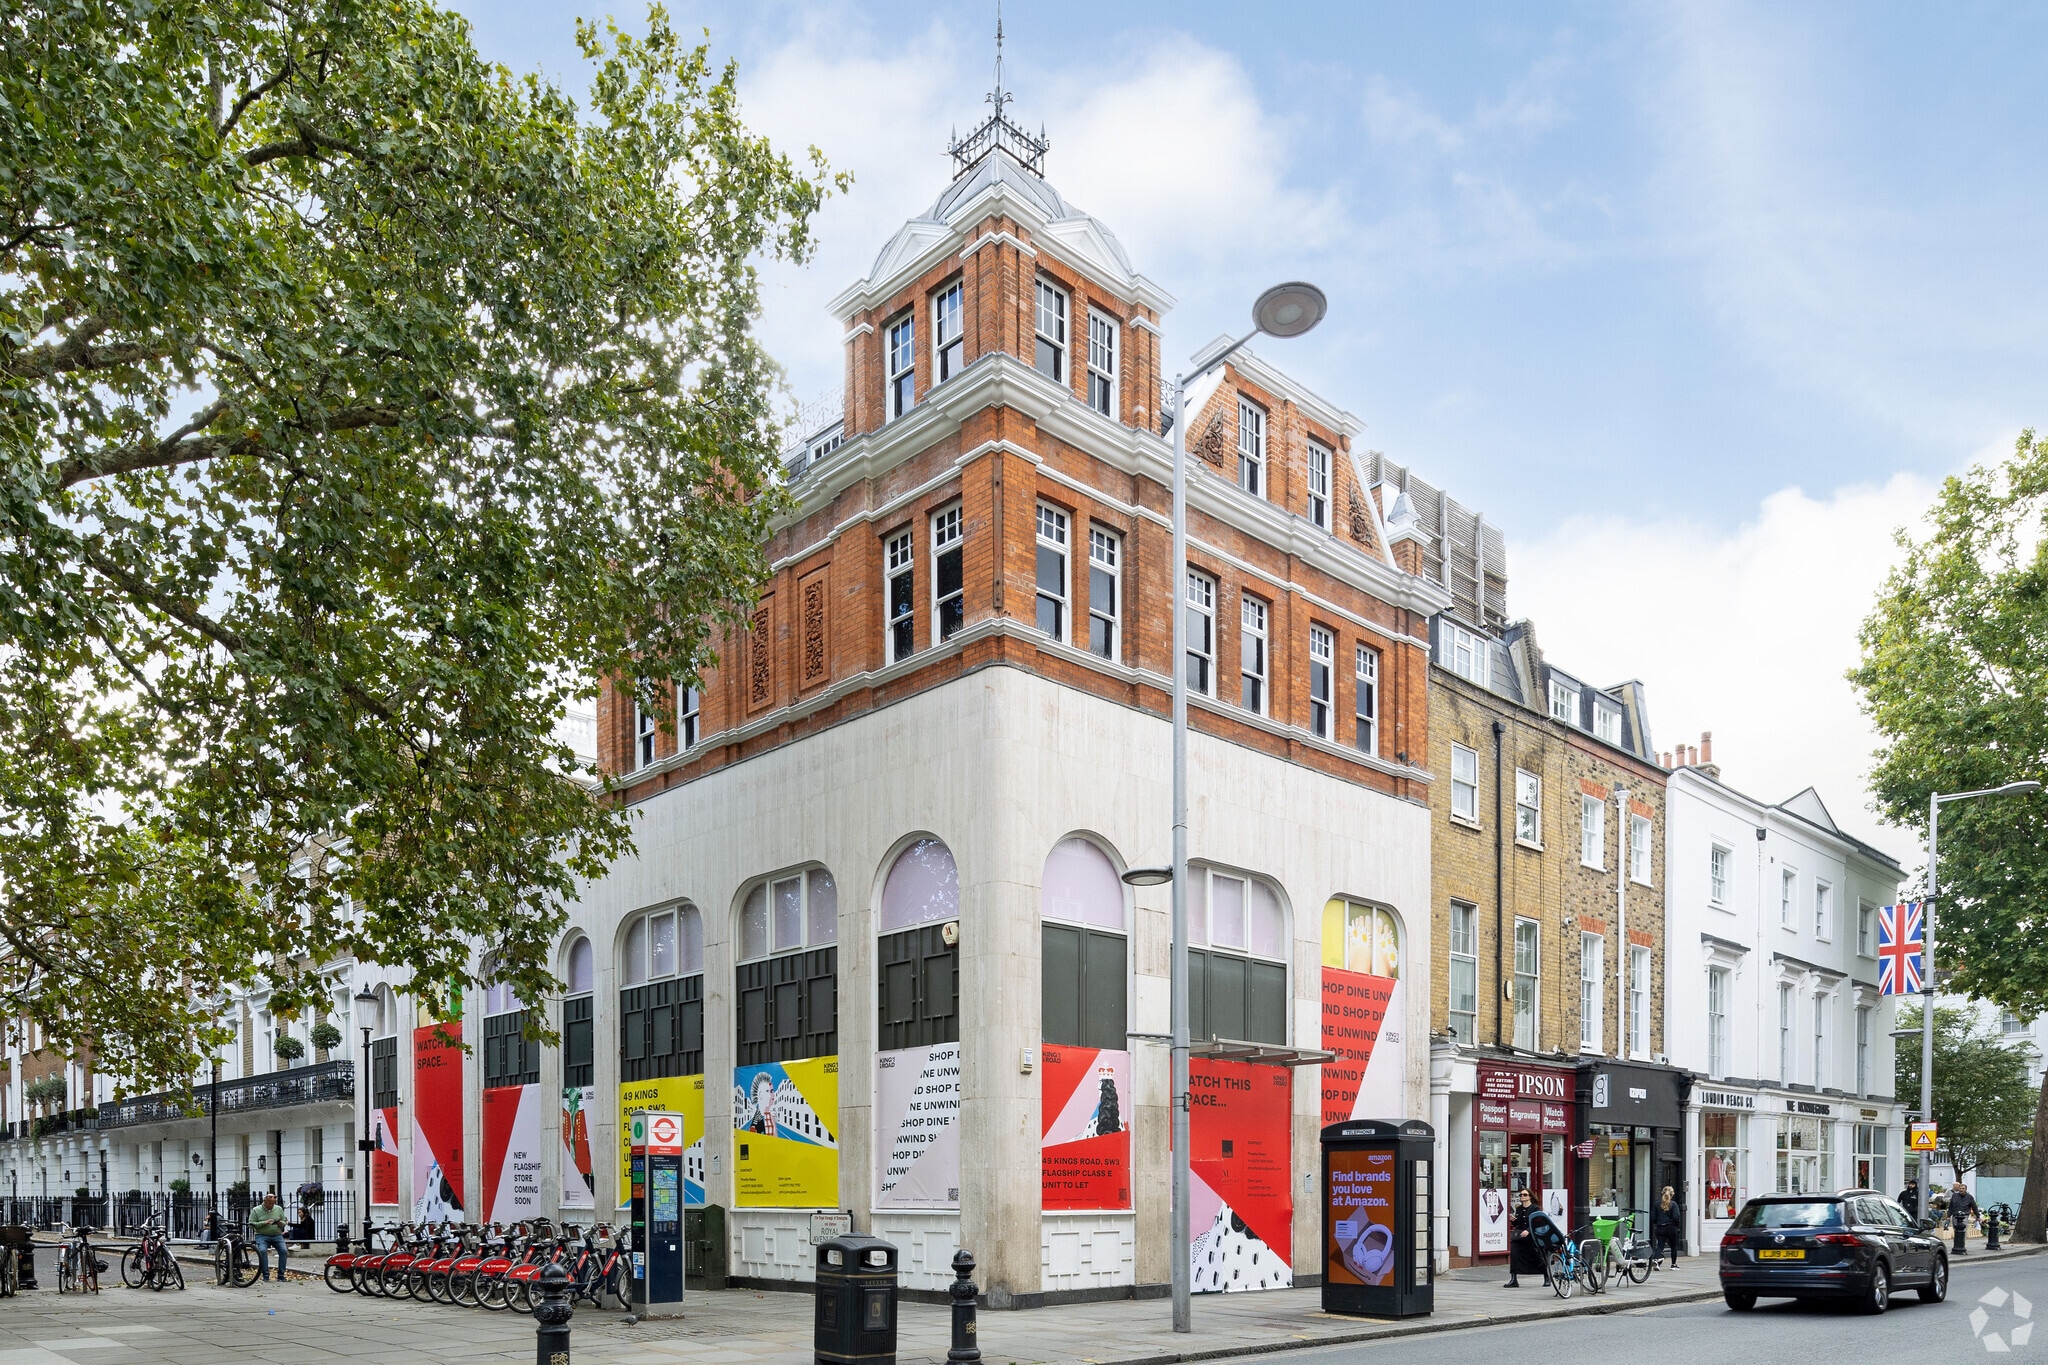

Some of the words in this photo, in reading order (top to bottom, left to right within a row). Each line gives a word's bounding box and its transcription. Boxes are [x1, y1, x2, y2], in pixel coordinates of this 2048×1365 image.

[1347, 985, 1370, 999] DINE
[1343, 1006, 1370, 1019] SHOP
[1337, 1027, 1377, 1042] UNWIND
[417, 1038, 443, 1052] WATCH
[929, 1051, 954, 1061] SHOP
[1347, 1049, 1370, 1061] DINE
[1321, 1068, 1357, 1081] NWIND
[926, 1084, 952, 1094] SHOP
[1224, 1077, 1251, 1091] THIS
[623, 1091, 633, 1101] 49
[634, 1088, 659, 1100] KINGS
[1702, 1091, 1724, 1105] LONDON
[1480, 1102, 1507, 1115] Passport
[1545, 1106, 1564, 1117] Watch
[1482, 1113, 1504, 1124] Photos
[1509, 1108, 1540, 1122] Engraving
[927, 1117, 949, 1126] DINE
[1543, 1117, 1566, 1128] Repairs
[1054, 1157, 1078, 1165] KINGS
[1104, 1158, 1120, 1166] SW3
[1368, 1154, 1392, 1162] amazon
[514, 1174, 532, 1182] STORE
[1042, 1169, 1080, 1177] FLAGSHIP
[1332, 1171, 1355, 1182] Find
[1355, 1171, 1391, 1182] brands
[514, 1186, 538, 1194] COMING
[1042, 1181, 1061, 1189] UNIT
[1063, 1181, 1073, 1189] TO
[1075, 1181, 1089, 1189] LET
[1332, 1185, 1350, 1196] you
[1352, 1183, 1372, 1194] love
[1708, 1187, 1733, 1200] SALE
[514, 1197, 531, 1205] SOON
[1332, 1196, 1343, 1206] at
[1344, 1196, 1389, 1207] Amazon.
